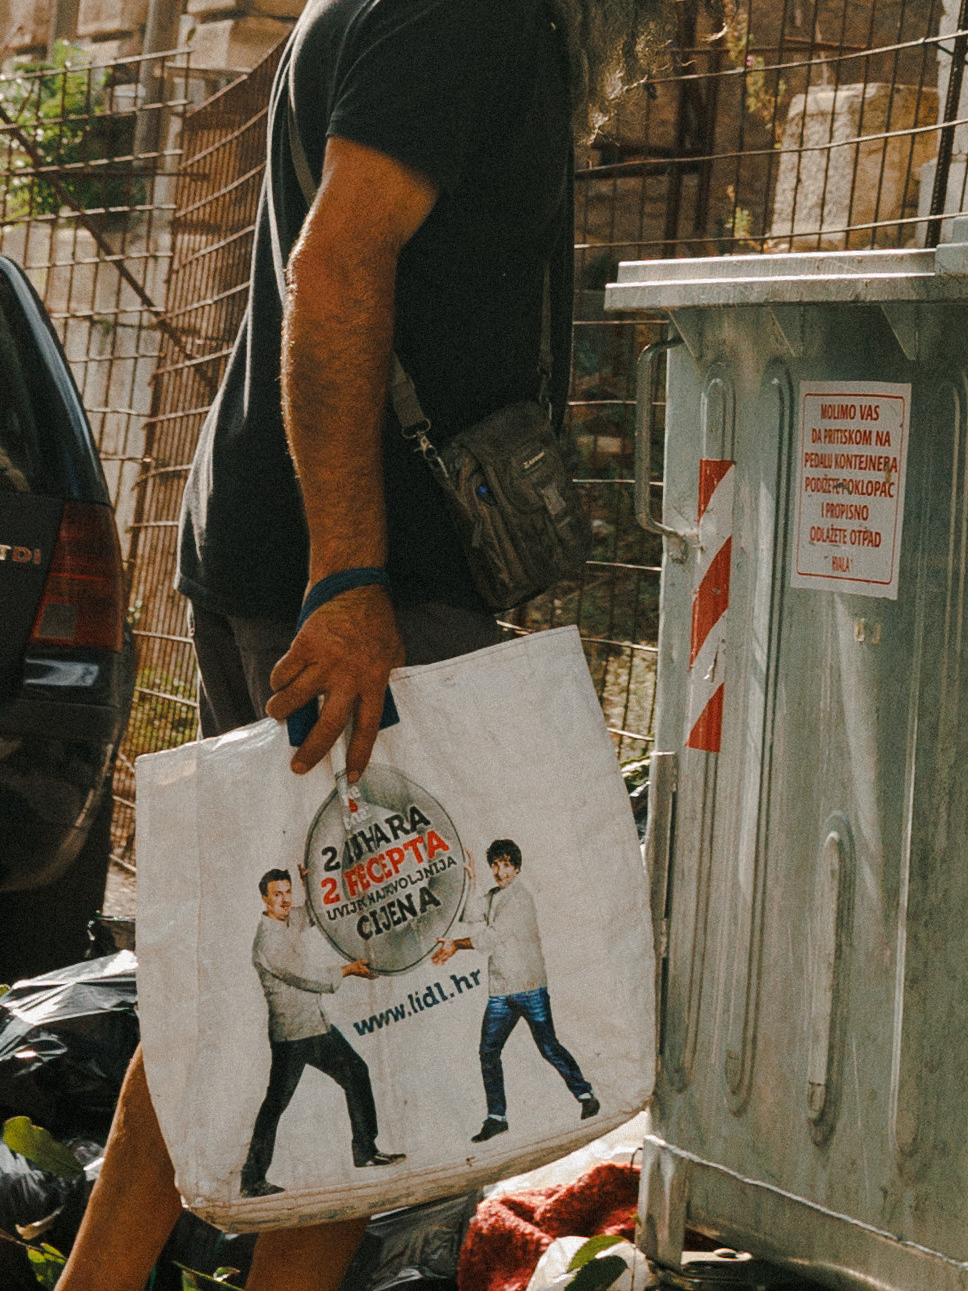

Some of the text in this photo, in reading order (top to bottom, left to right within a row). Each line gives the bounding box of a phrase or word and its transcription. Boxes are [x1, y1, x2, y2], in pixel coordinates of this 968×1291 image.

[820, 404, 880, 421] MOLIMO VAS
[811, 428, 891, 447] DA PRITISKOM NA
[804, 452, 898, 472] PEDALU KONTEJNERA
[842, 478, 895, 498] POKLOPAC
[821, 502, 869, 521] I PROPISNO
[809, 524, 881, 547] ODLAŽETE OTPAD
[321, 846, 341, 872] 2
[320, 877, 341, 905] 2
[356, 886, 442, 941] CIJENA
[353, 969, 481, 1037] www.lidl.hr
